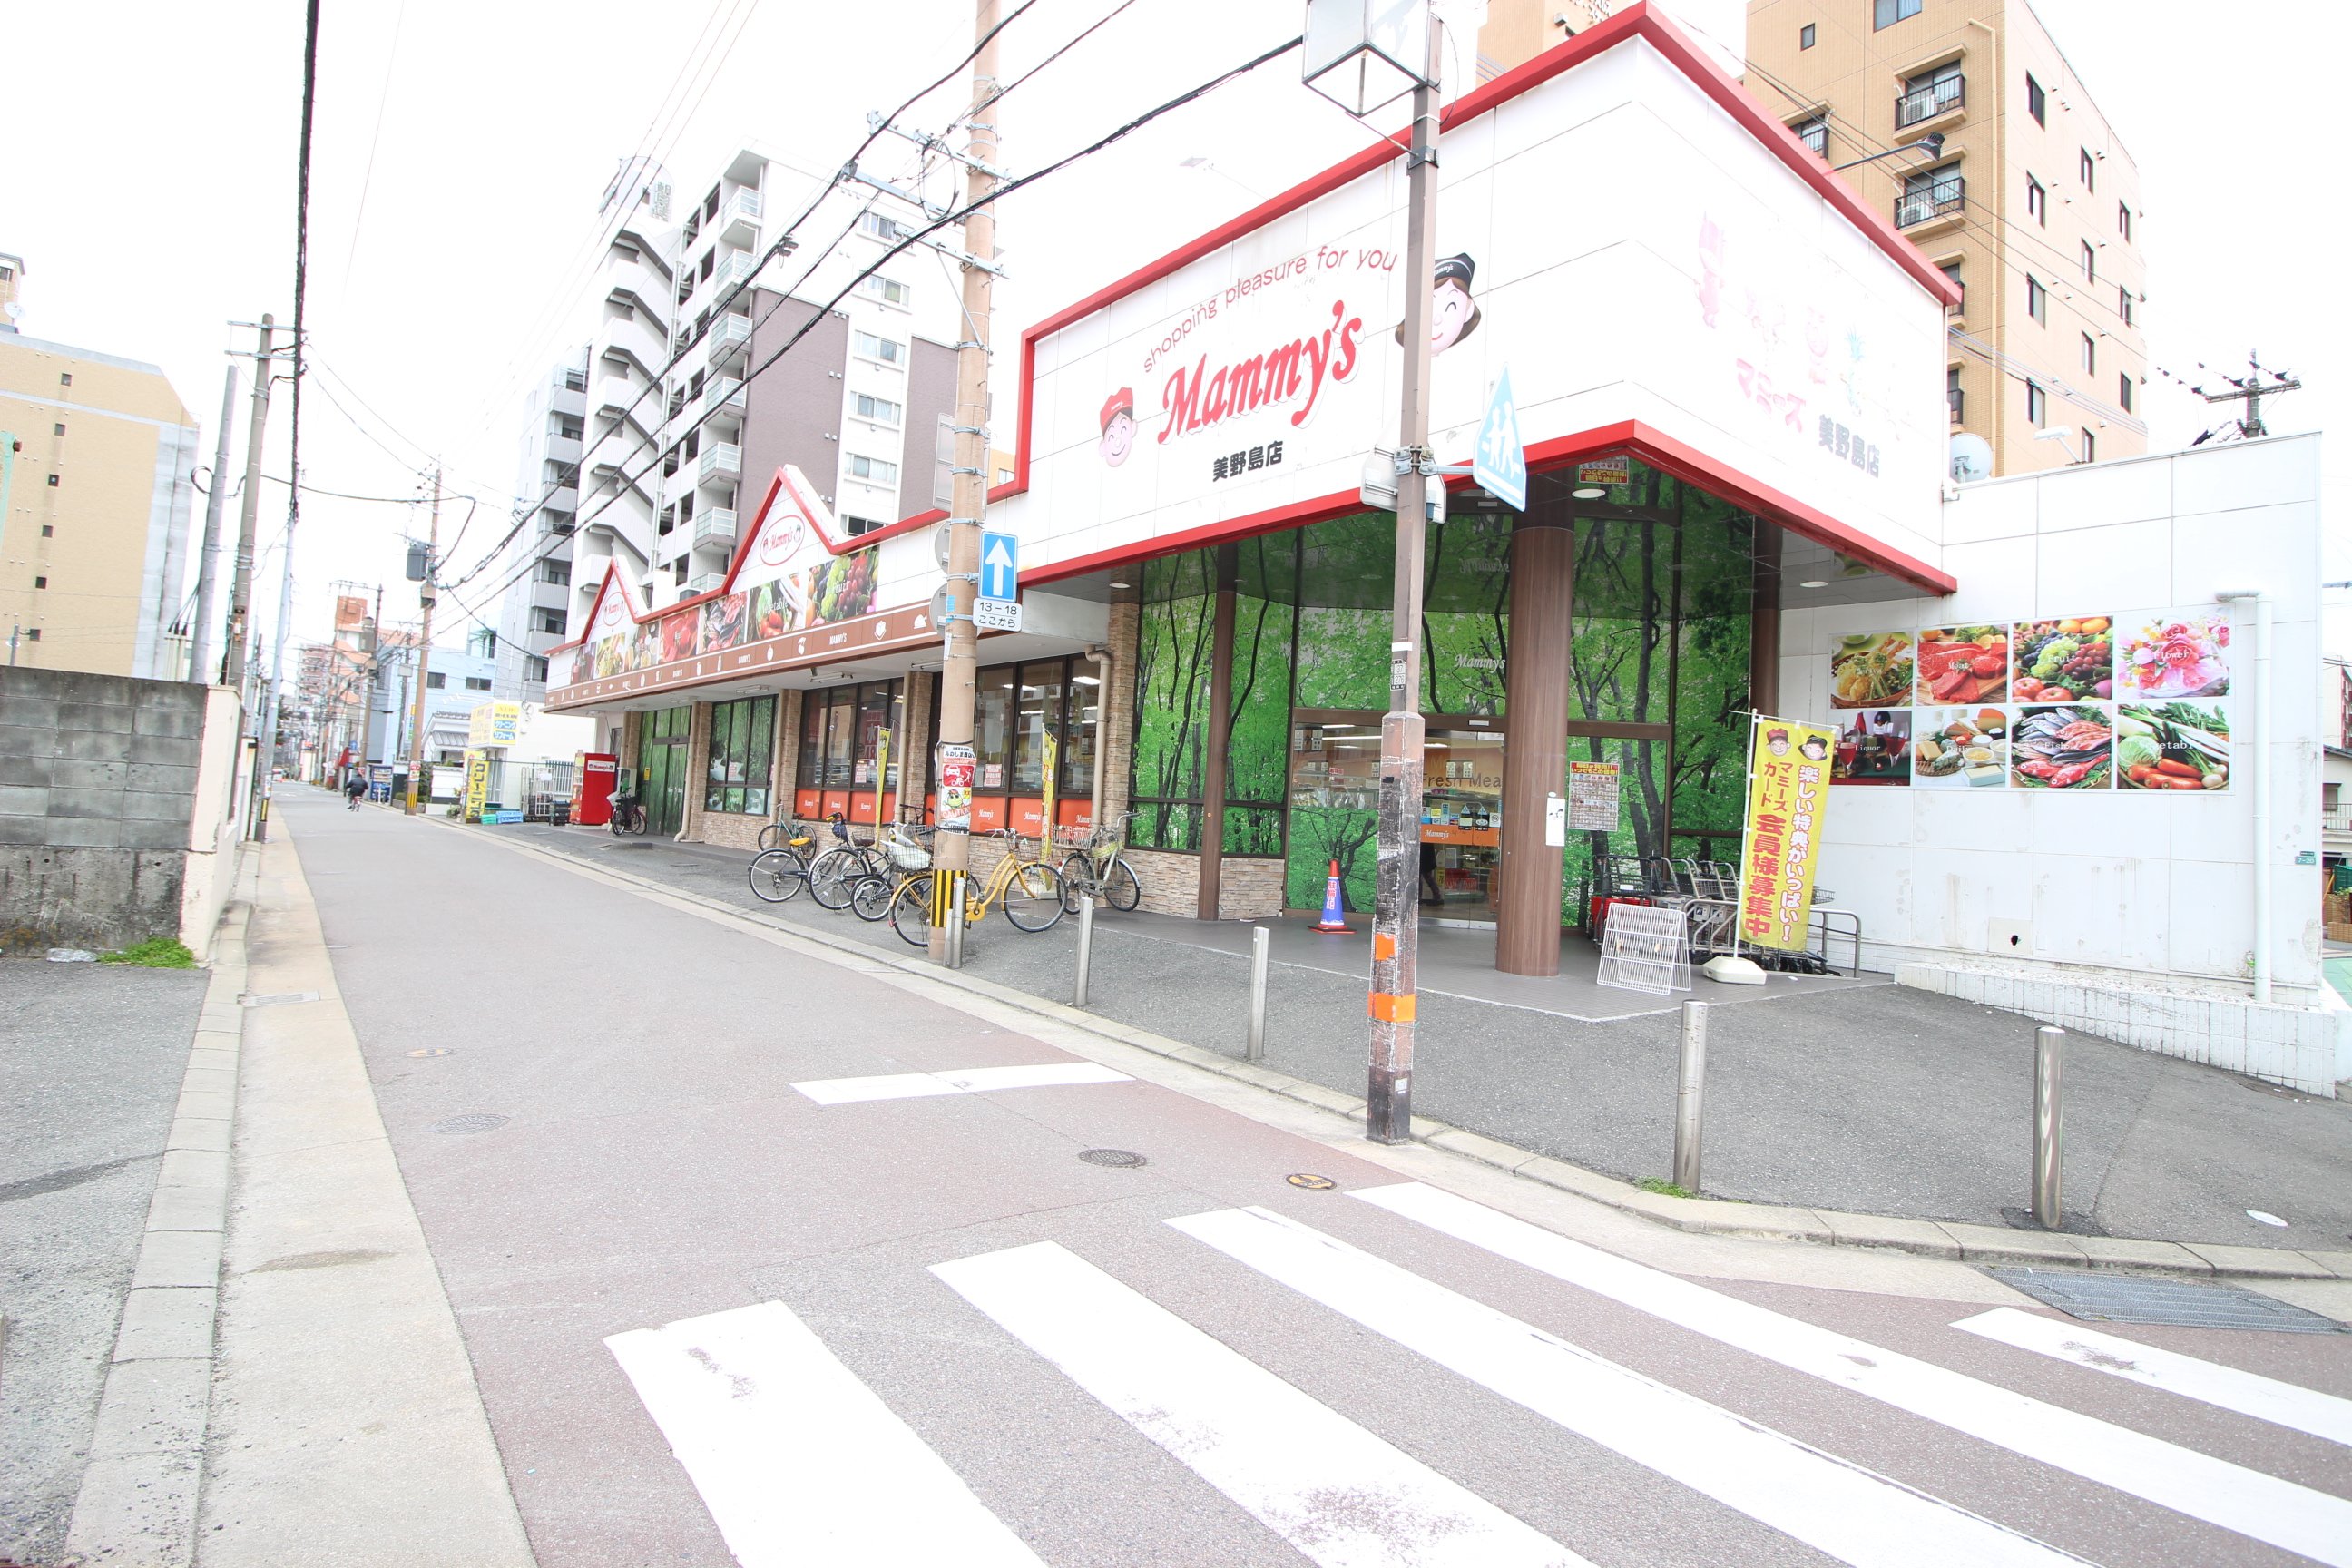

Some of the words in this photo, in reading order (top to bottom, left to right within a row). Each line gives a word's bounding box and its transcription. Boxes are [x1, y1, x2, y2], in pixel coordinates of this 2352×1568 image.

[1142, 297, 1218, 373] shopping
[1225, 256, 1307, 308] pleasure
[1317, 245, 1348, 270] for
[1356, 248, 1398, 272] you
[1157, 299, 1362, 445] Mammy's
[1211, 440, 1284, 482] 美野島店
[1818, 413, 1880, 479] 美野島店
[978, 614, 1016, 628] ここから
[1454, 652, 1506, 673] Mammy's
[2048, 653, 2077, 662] Fruit
[2153, 650, 2190, 660] Flower
[1854, 743, 1881, 752] Liquor
[1469, 772, 1502, 788] Mea
[1760, 761, 1778, 808] カード
[1772, 761, 1793, 813] マミーズ
[1425, 828, 1449, 840] Mammy's
[1744, 813, 1787, 938] 会員様募集中
